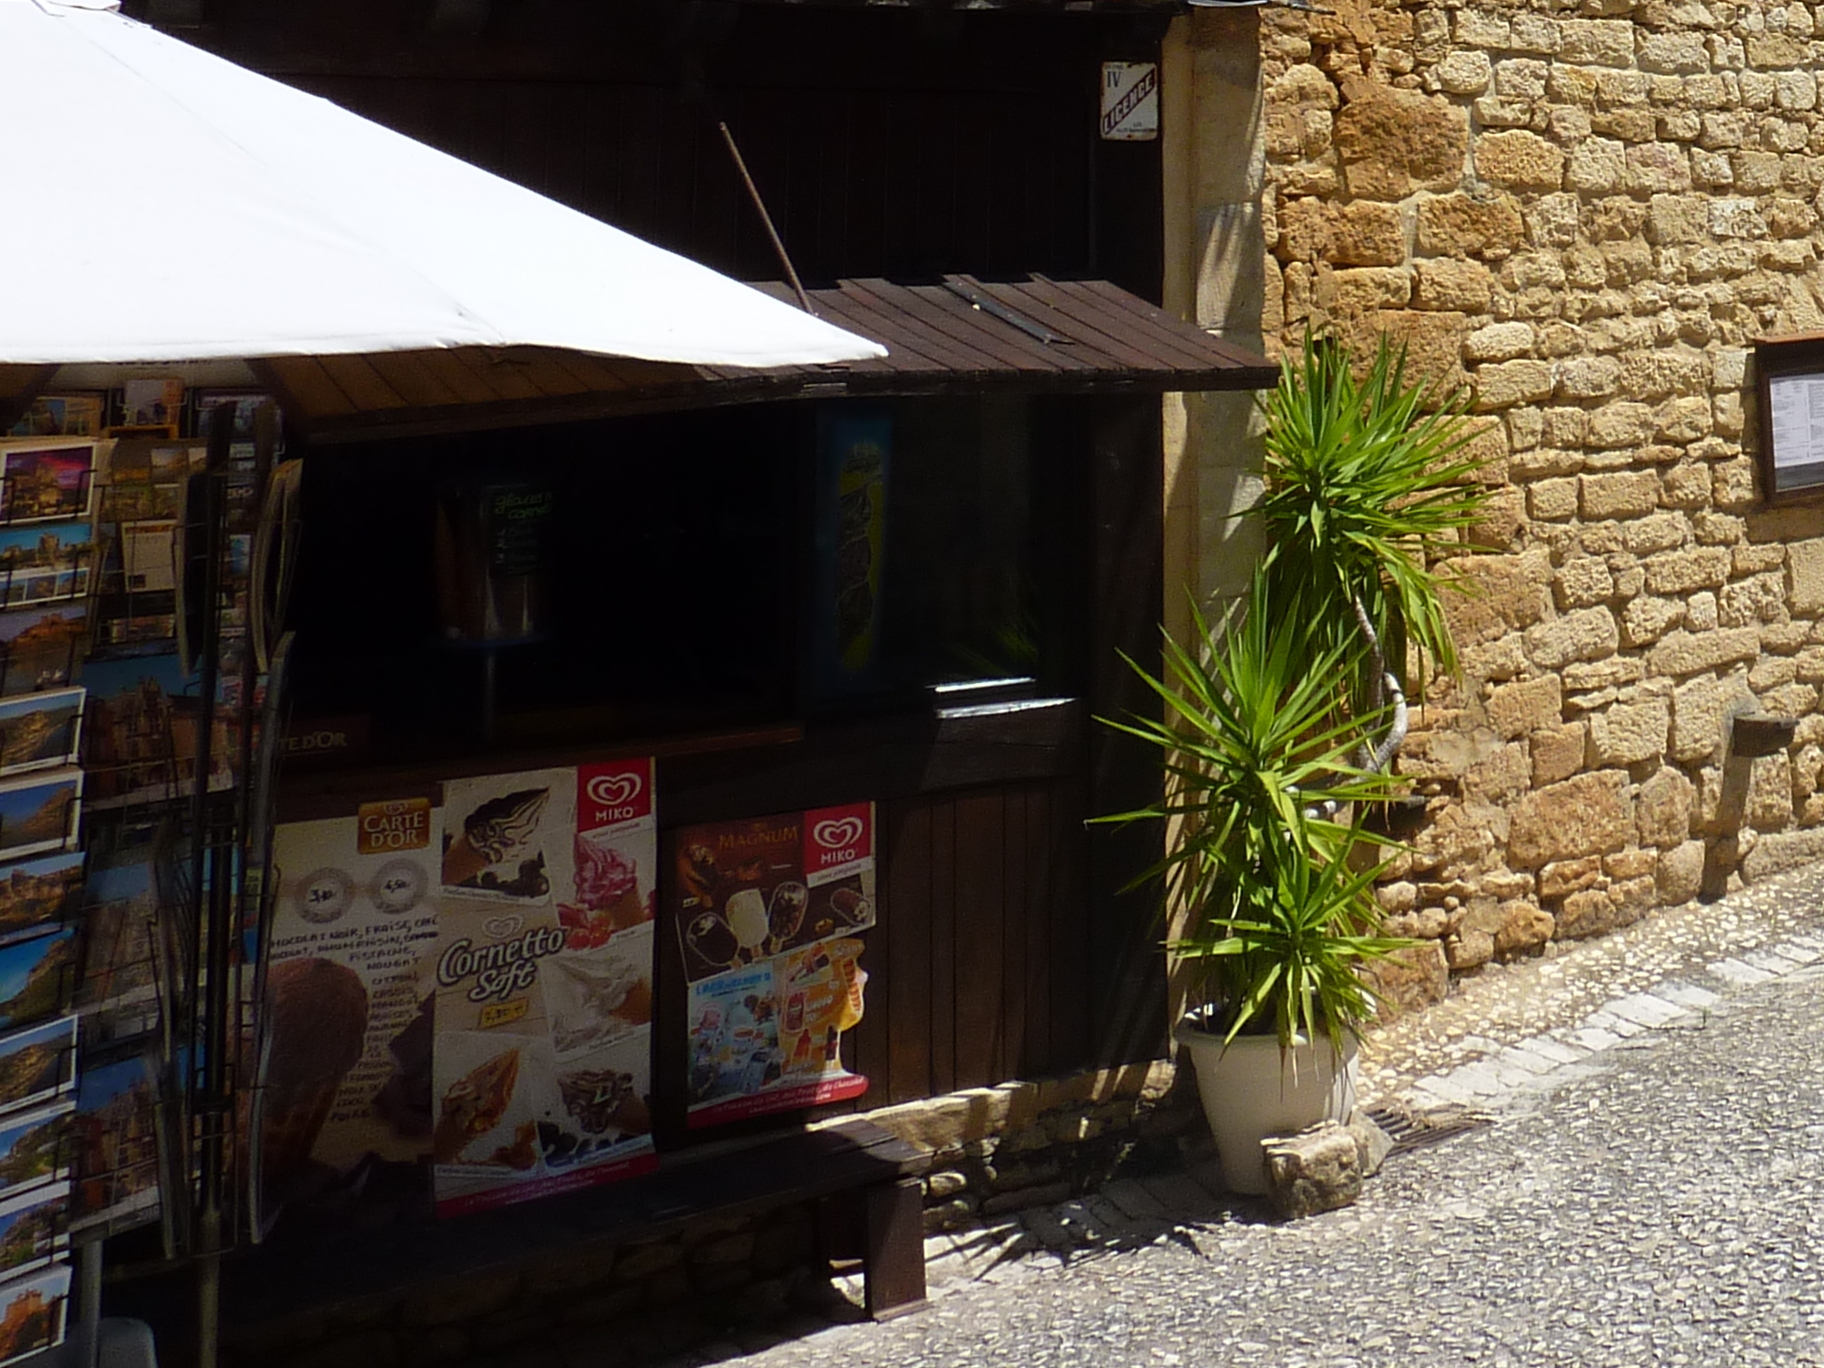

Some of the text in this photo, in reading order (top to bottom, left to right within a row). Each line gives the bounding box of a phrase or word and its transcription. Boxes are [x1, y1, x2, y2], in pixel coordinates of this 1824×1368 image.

[1103, 72, 1154, 134] LICENCE
[364, 811, 424, 833] CARTE
[595, 806, 635, 822] MIKO
[371, 829, 418, 847] D'OR
[719, 826, 799, 850] MAGNUM
[821, 849, 855, 864] MIKO
[438, 927, 566, 986] Cornetto
[469, 959, 536, 1000] Soft
